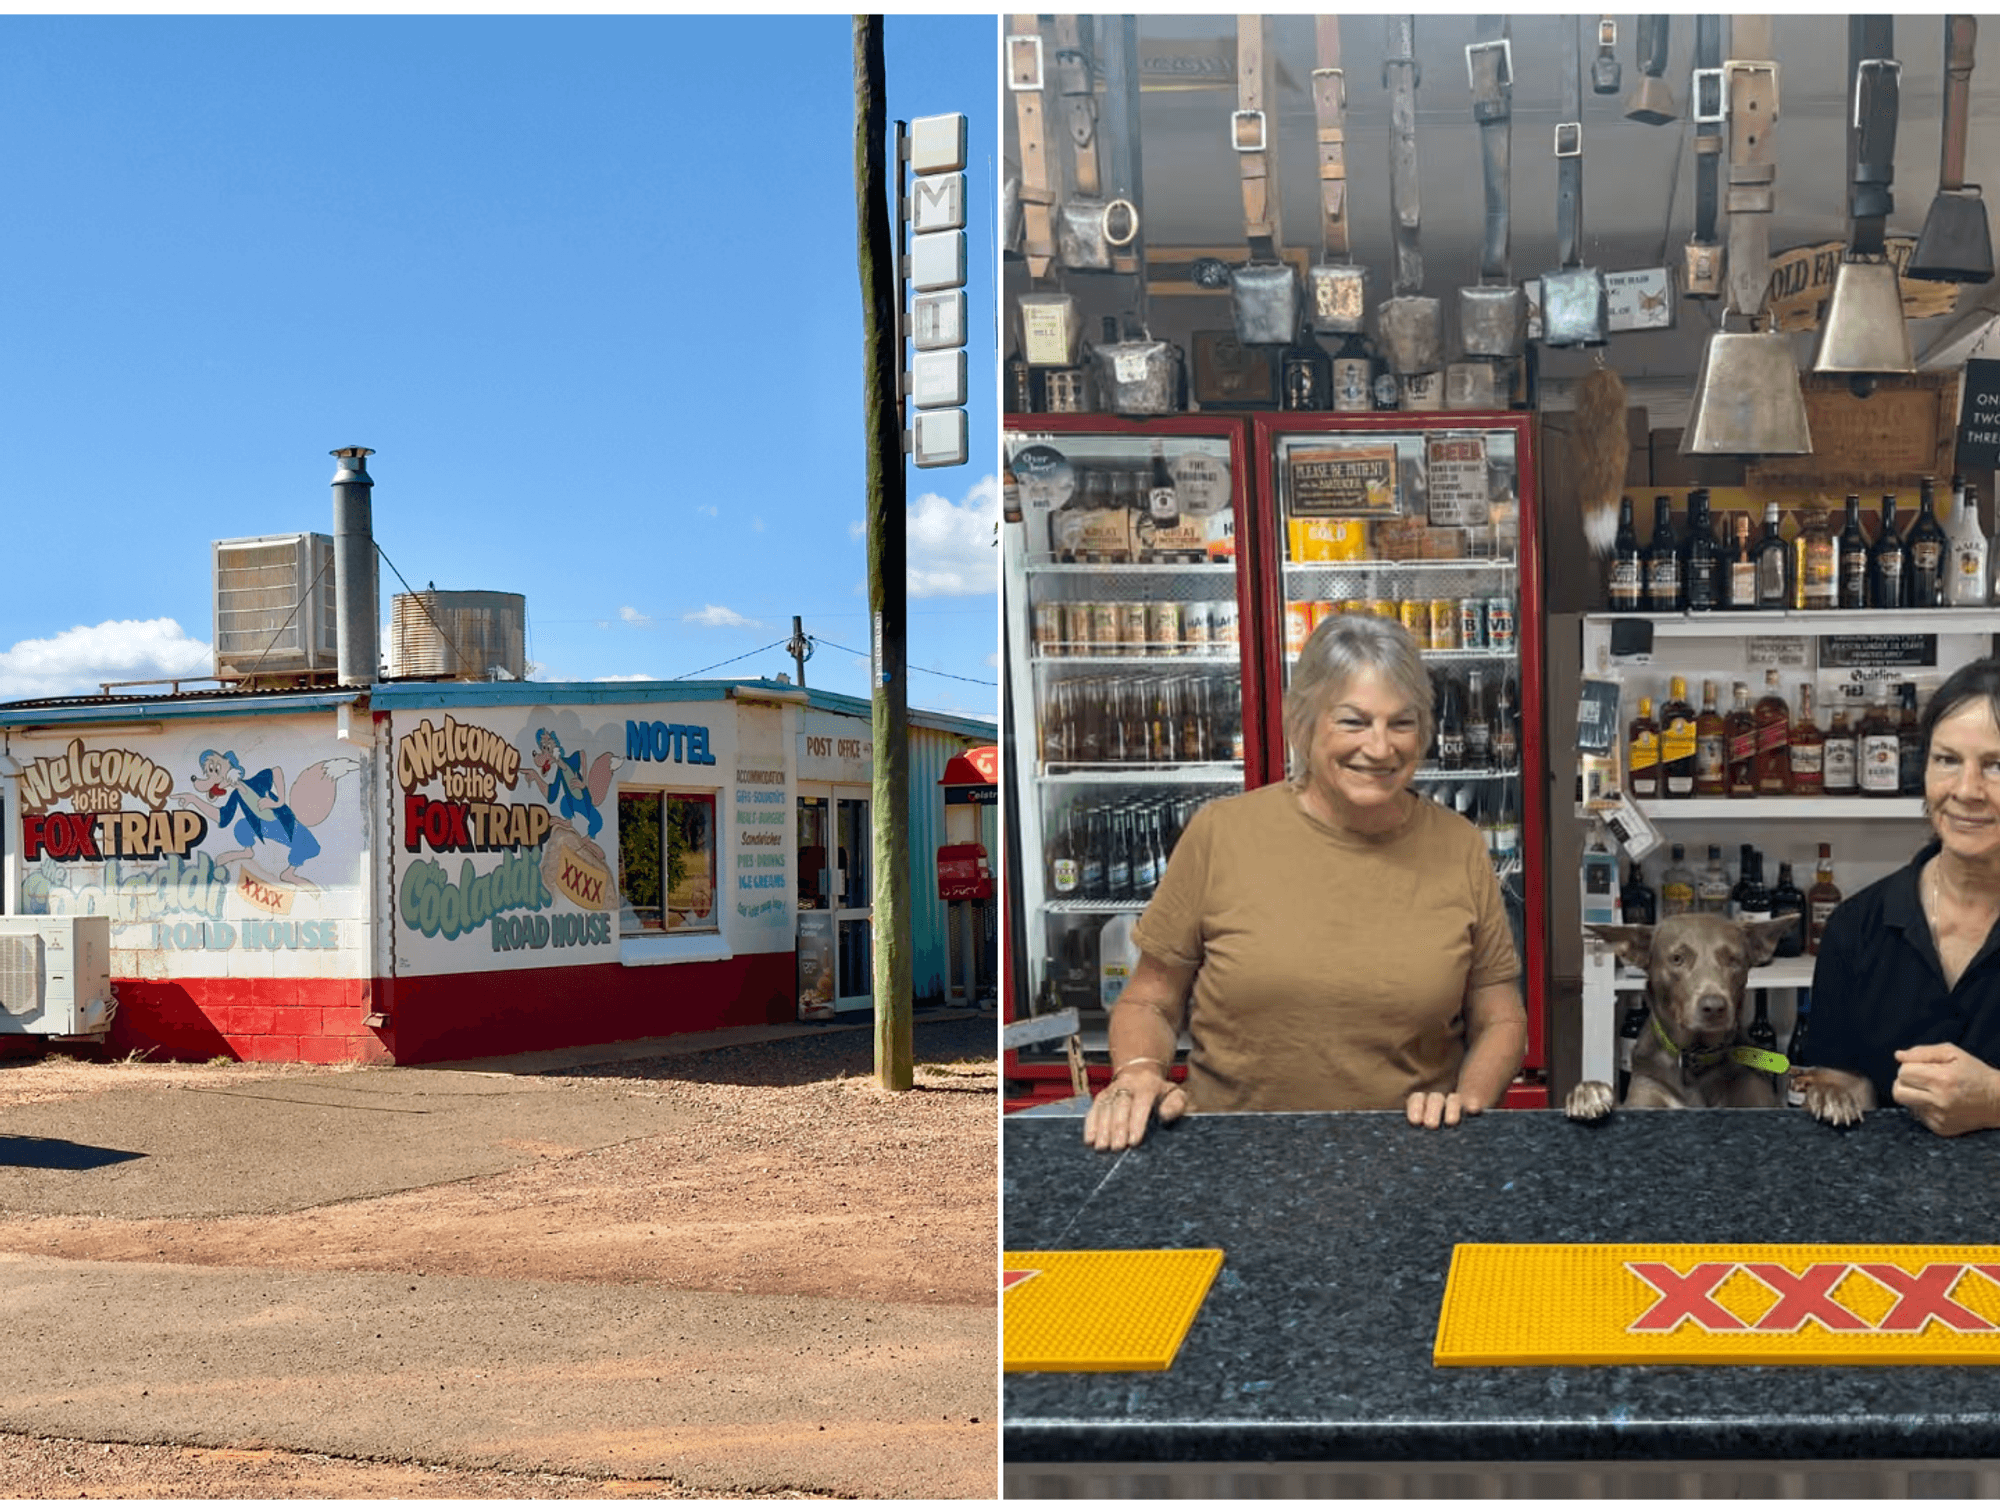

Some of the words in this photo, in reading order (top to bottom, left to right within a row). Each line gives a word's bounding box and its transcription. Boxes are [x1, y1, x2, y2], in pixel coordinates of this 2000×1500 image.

[1772, 258, 1809, 302] OLD
[398, 713, 522, 795] Welcome
[625, 720, 716, 766] MOTEL
[807, 736, 832, 756] POST
[837, 738, 860, 758] OFFICE
[20, 738, 174, 811] Welcome
[21, 811, 104, 862] FOX
[97, 810, 208, 861] TRAP
[404, 794, 475, 863] FOX
[469, 803, 553, 863] TRAP
[151, 921, 237, 951] ROAD
[240, 918, 339, 951] HOUSE
[491, 913, 550, 952] ROAD
[551, 912, 612, 948] HOUSE
